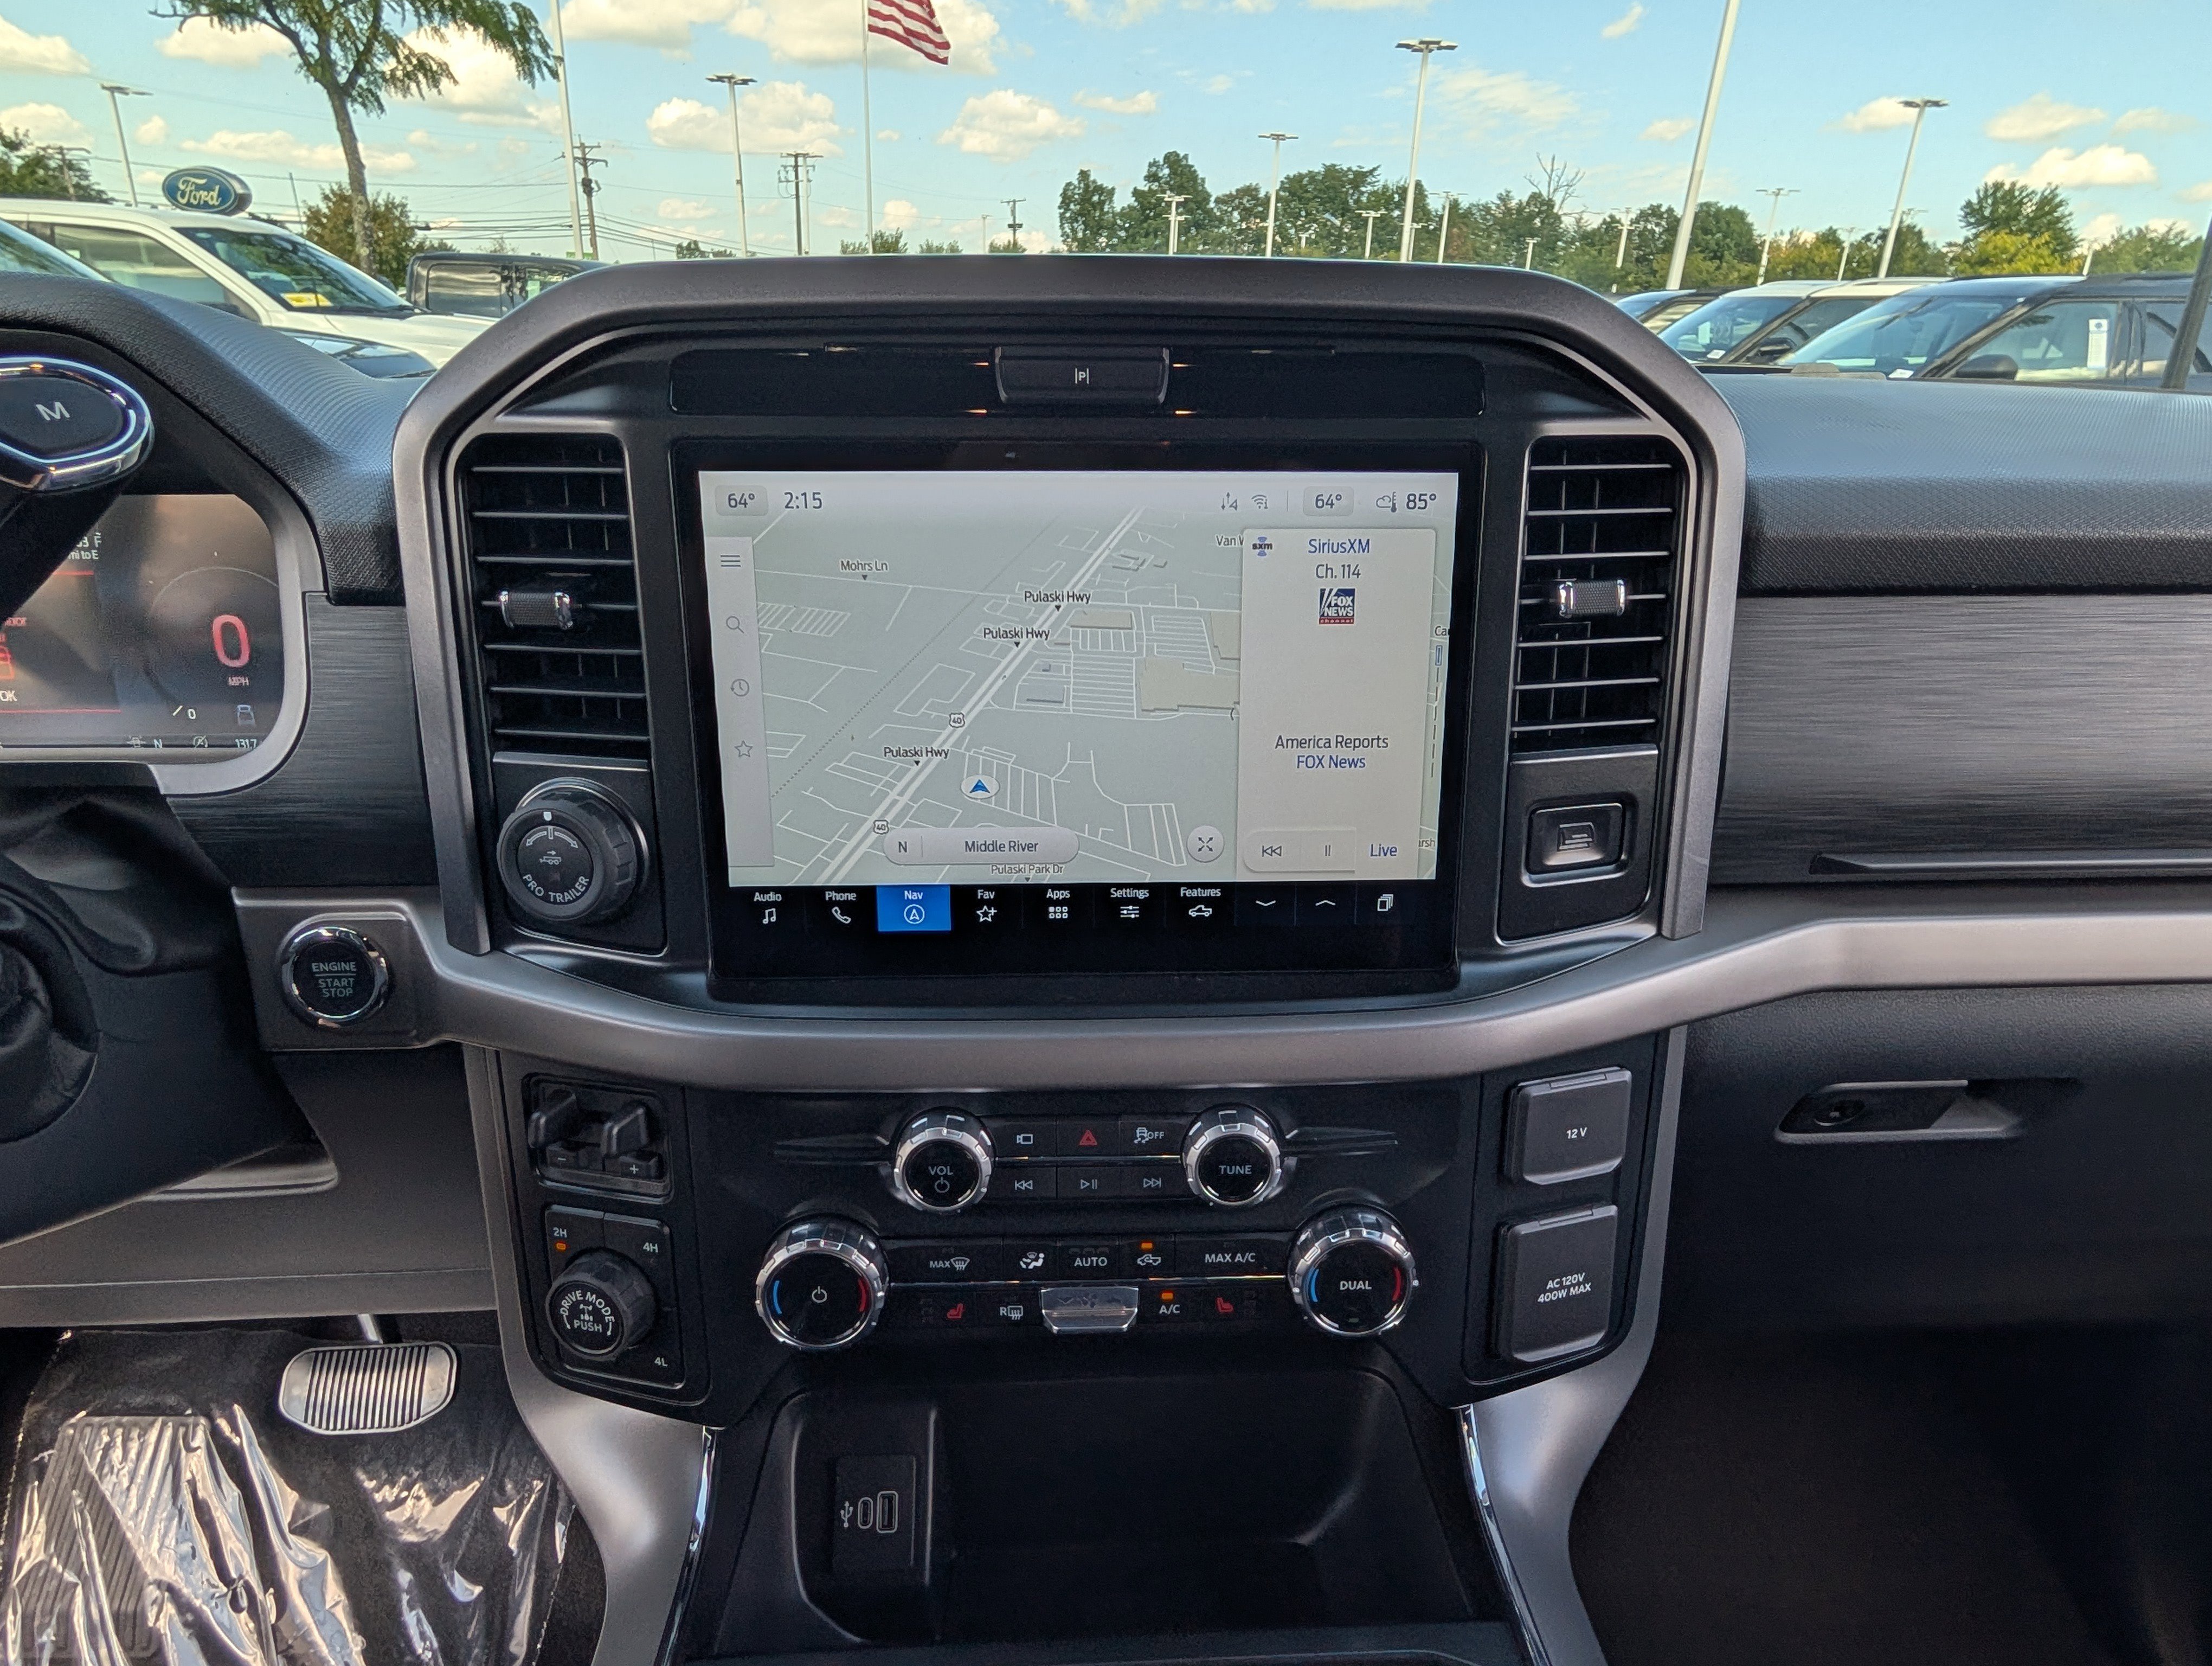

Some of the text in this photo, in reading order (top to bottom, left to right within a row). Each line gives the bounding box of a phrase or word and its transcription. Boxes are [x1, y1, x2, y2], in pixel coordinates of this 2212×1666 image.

[178, 177, 221, 207] Ford
[36, 402, 70, 420] M
[728, 492, 822, 509] 64° 2:15
[1316, 494, 1436, 509] 64° 85°
[1216, 535, 1236, 547] Van
[1308, 539, 1371, 555] SiriusXM
[841, 560, 888, 572] Mohrs Ln
[1316, 563, 1361, 578] Ch. 114
[1025, 591, 1091, 604] Pulaski Hwy
[1330, 596, 1353, 606] FOX
[1324, 607, 1354, 616] NEWS
[983, 627, 1050, 640] Pulaski Hwy
[212, 614, 250, 668] 0
[0, 690, 17, 702] OK
[154, 739, 163, 748] N
[1275, 735, 1389, 751] America Reports
[884, 747, 949, 759] Pulaski Hwy
[1297, 755, 1366, 769] FOX News
[898, 842, 907, 853] N
[964, 840, 1039, 853] Middle River
[1371, 844, 1397, 856] Live
[991, 864, 1064, 874] Pulaski Park Dr
[522, 873, 590, 904] PRO TRAILER
[978, 889, 994, 899] Fav
[1111, 888, 1149, 899] Settings
[1181, 887, 1221, 896] Features
[754, 892, 782, 901] Audio
[826, 891, 856, 900] Phone
[905, 890, 923, 899] Nav
[1046, 889, 1070, 900] Apps
[312, 962, 356, 971] ENGINE
[319, 978, 354, 988] START
[323, 988, 352, 997] STOP
[1148, 1131, 1165, 1139] OFF
[1567, 1127, 1587, 1138] 12 V
[929, 1166, 953, 1175] VOL
[1219, 1165, 1251, 1174] TUNE
[554, 1227, 567, 1238] 2H
[643, 1242, 658, 1252] 4H
[1075, 1257, 1107, 1266] AUTO
[1205, 1253, 1255, 1263] MAX A/C
[1340, 1281, 1372, 1290] DUAL
[1547, 1273, 1585, 1289] AC 120V
[1538, 1283, 1591, 1302] 400W MAX
[560, 1290, 615, 1323] DRIVE MODE
[1160, 1304, 1180, 1314] A/C
[574, 1319, 602, 1332] PUSH
[654, 1357, 667, 1367] 4L
